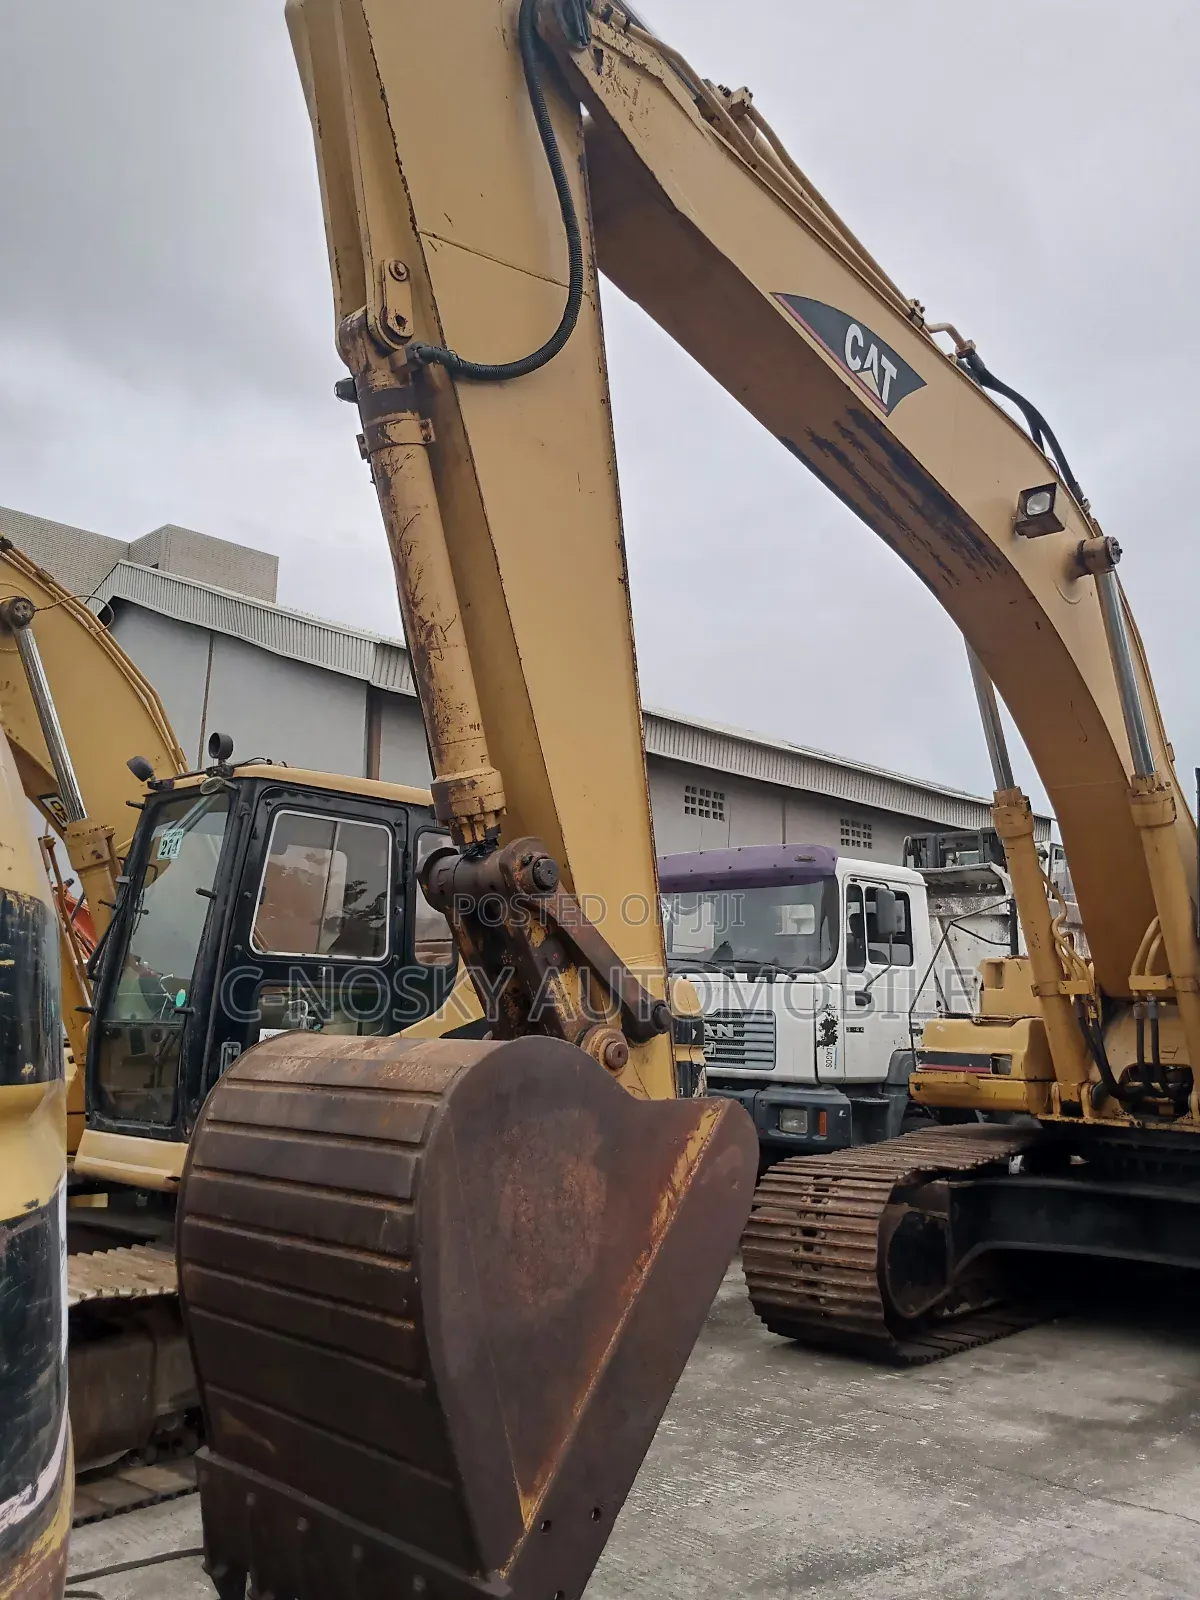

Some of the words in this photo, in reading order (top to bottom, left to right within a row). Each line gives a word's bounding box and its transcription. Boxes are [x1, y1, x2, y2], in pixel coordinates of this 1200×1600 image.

[845, 323, 898, 405] CAT
[703, 1023, 735, 1039] AN
[825, 1047, 833, 1068] LAGOS
